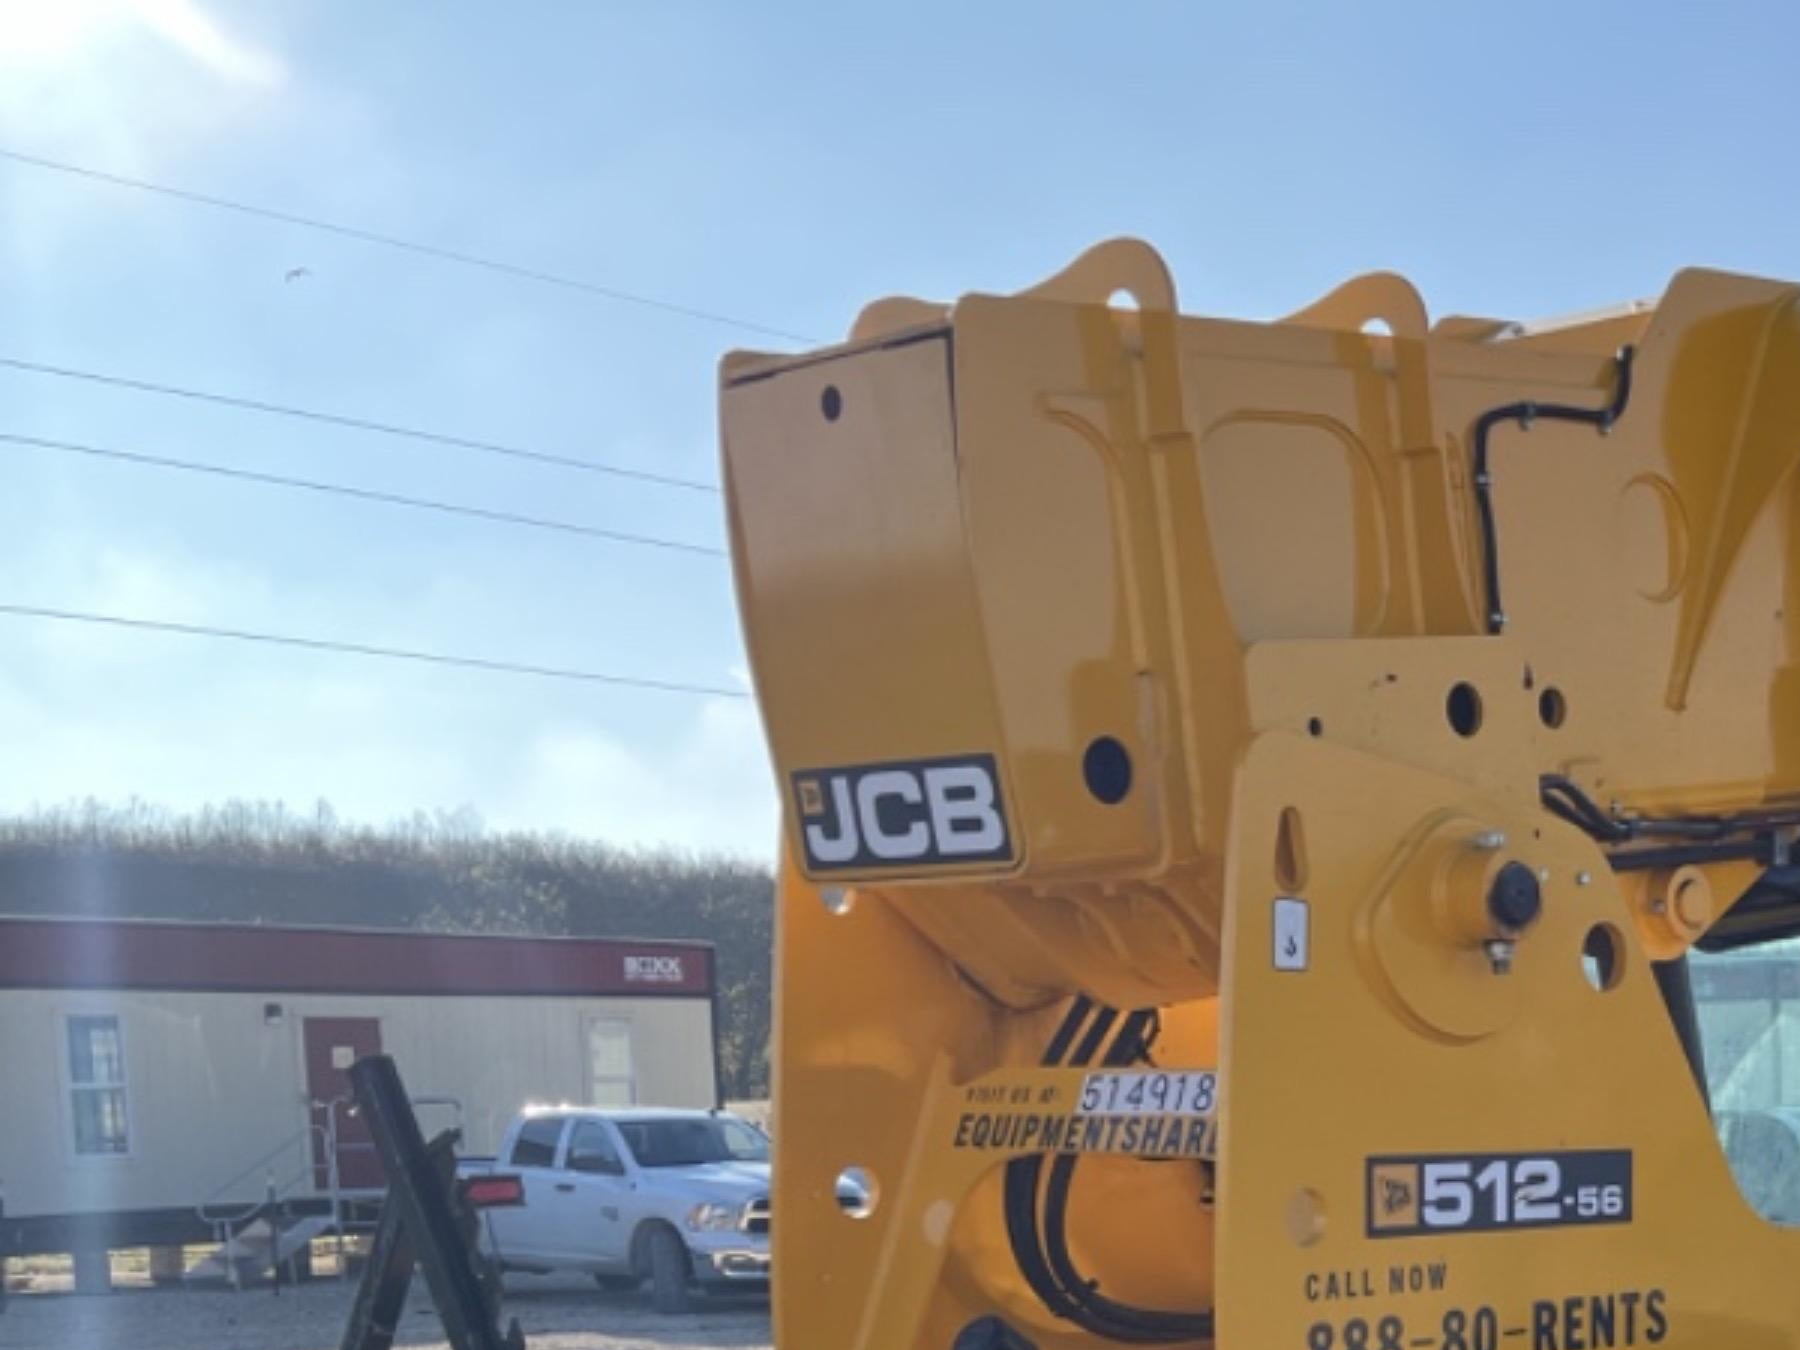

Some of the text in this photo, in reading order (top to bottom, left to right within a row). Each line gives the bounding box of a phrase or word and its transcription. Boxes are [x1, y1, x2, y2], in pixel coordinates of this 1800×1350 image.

[806, 765, 1005, 863] JCB
[1082, 1073, 1216, 1112] 514918
[1305, 1262, 1447, 1301] CALL NOW
